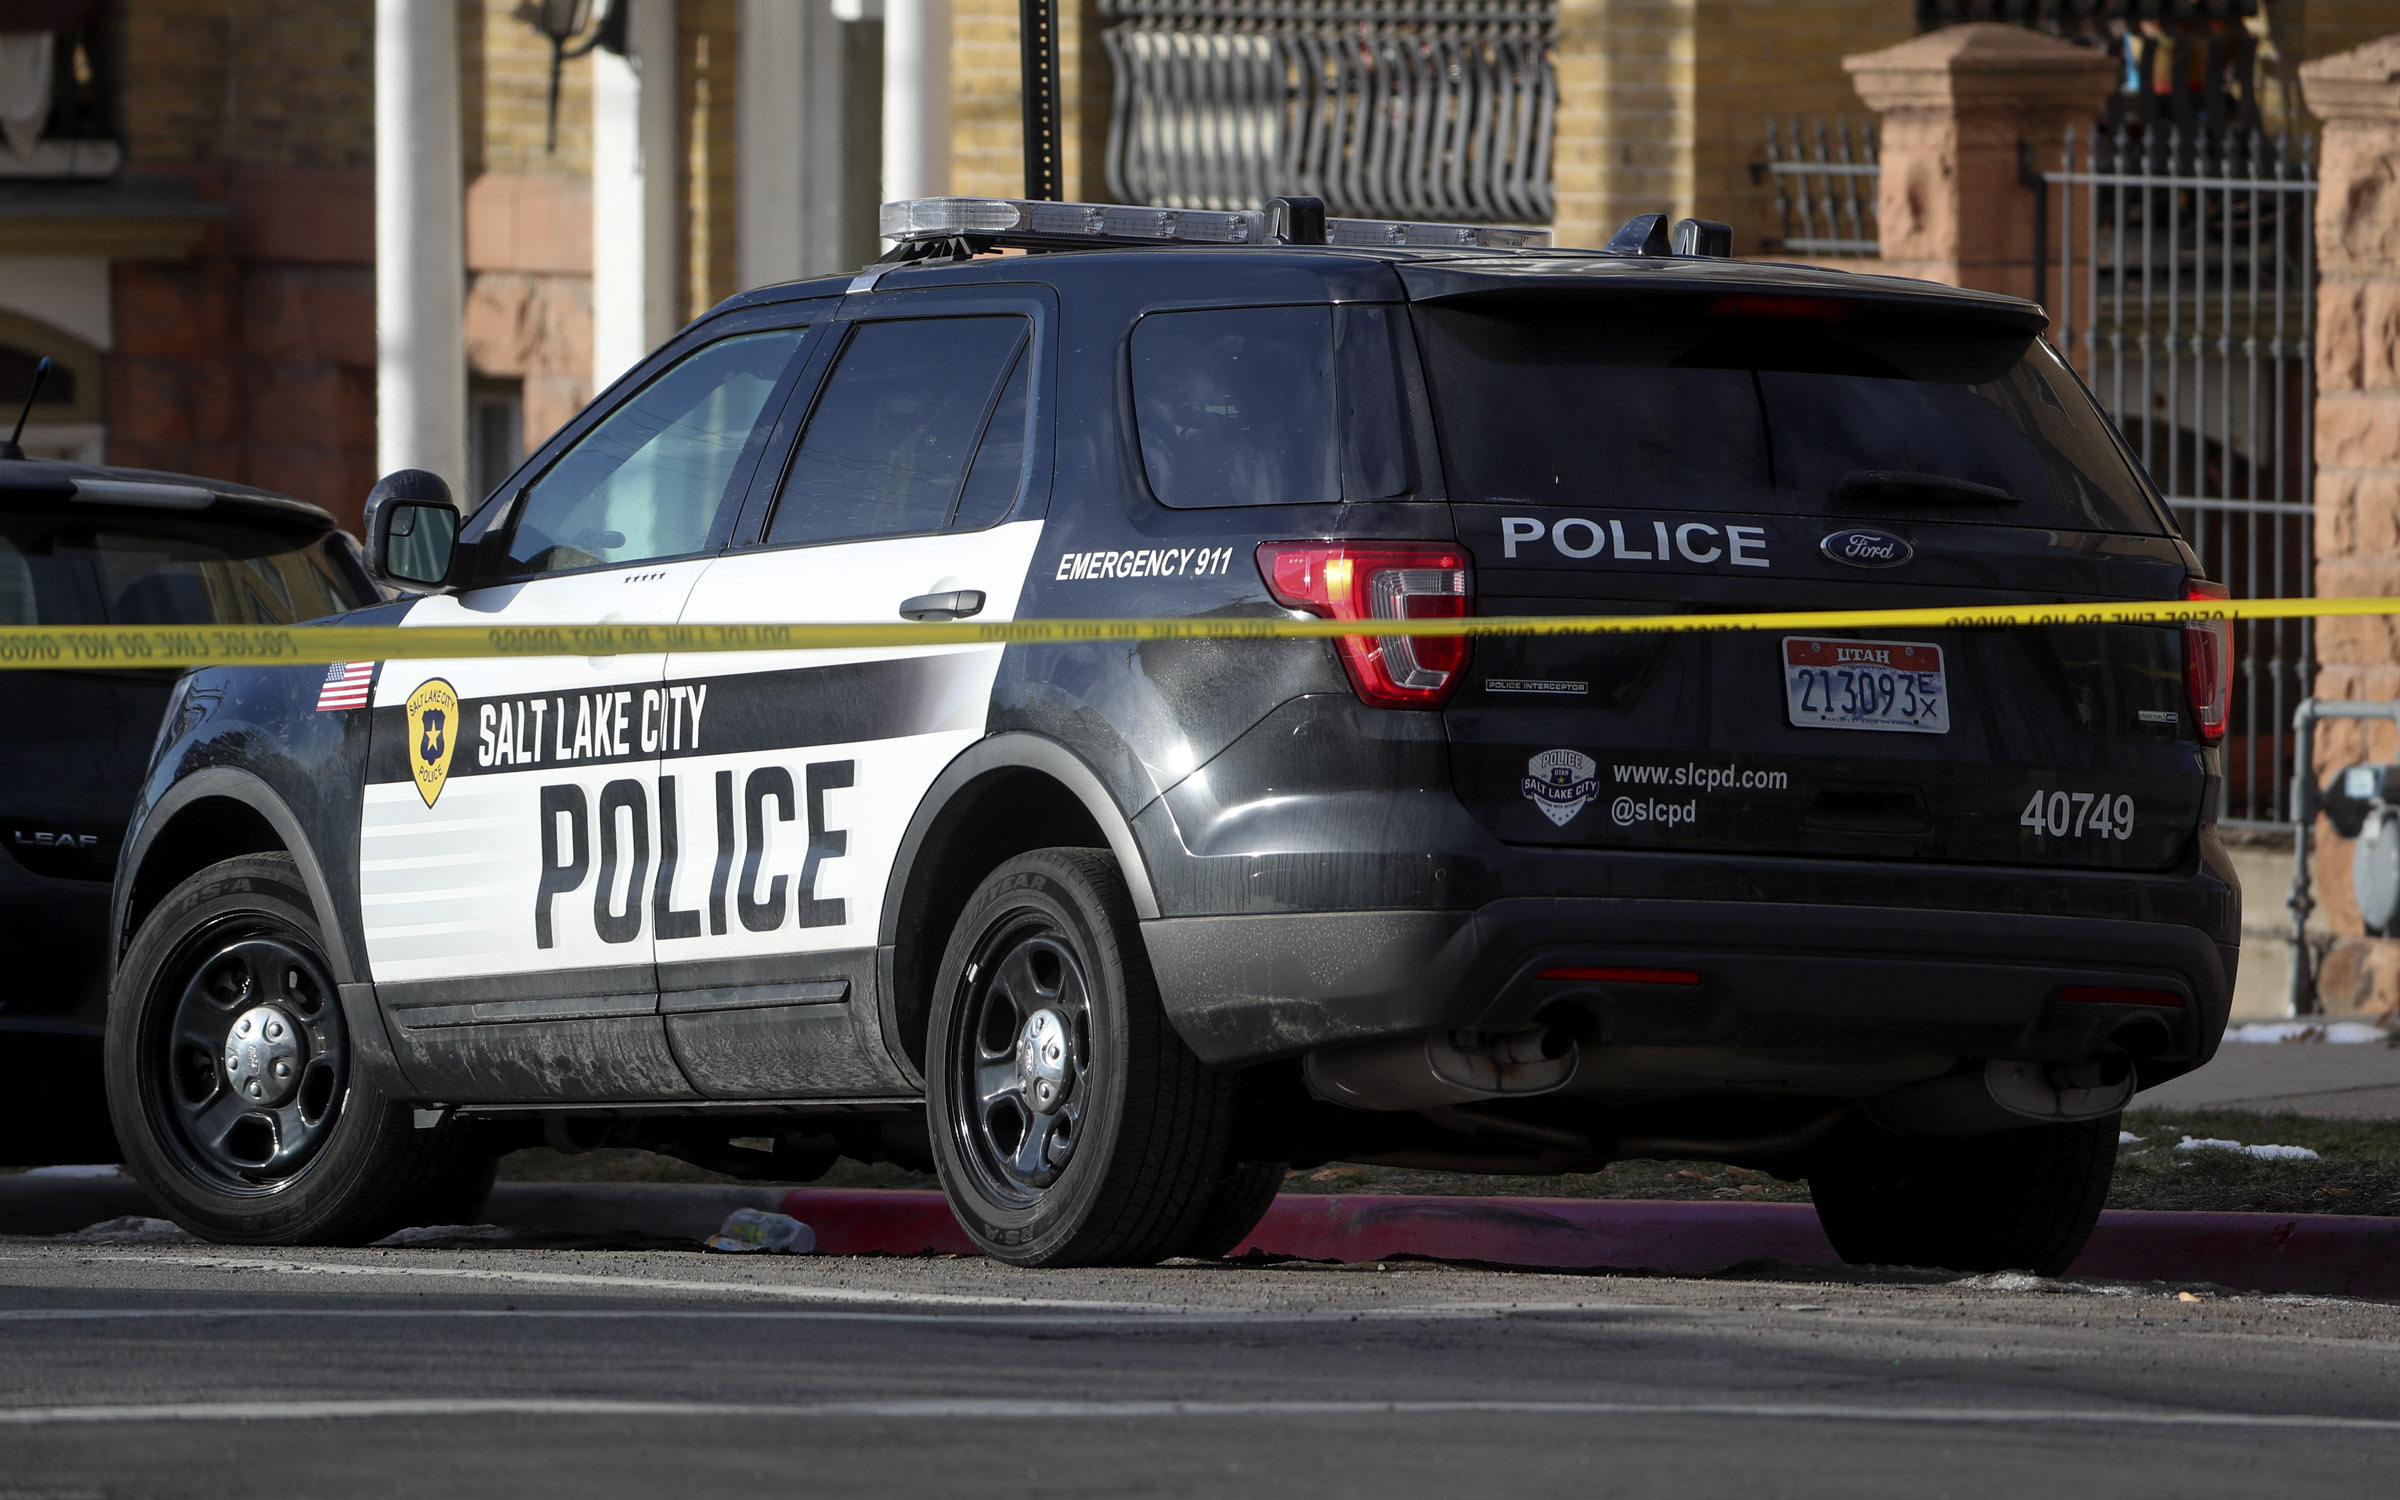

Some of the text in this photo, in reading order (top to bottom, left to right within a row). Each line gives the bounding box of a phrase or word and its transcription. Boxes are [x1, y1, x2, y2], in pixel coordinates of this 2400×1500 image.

[1500, 516, 1770, 568] POLICE
[1844, 533, 1895, 560] Ford
[1055, 546, 1234, 581] EMERGENCY 911
[1836, 647, 1891, 664] UTAH
[1489, 681, 1585, 691] POLICE INTERCEPTOR
[1798, 669, 1918, 718] 213093
[408, 689, 456, 717] SALT LAKE CITY
[477, 683, 708, 767] SALT LAKE CITY
[418, 763, 444, 783] POLICE
[1542, 751, 1583, 769] POLICE
[1524, 778, 1597, 800] SALT LAKE CITY
[1613, 761, 1788, 792] www.slcpd.com
[1611, 795, 1697, 828] @slcpd
[2020, 789, 2135, 841] 40749
[14, 830, 98, 848] LEAF
[535, 758, 857, 950] POLICE
